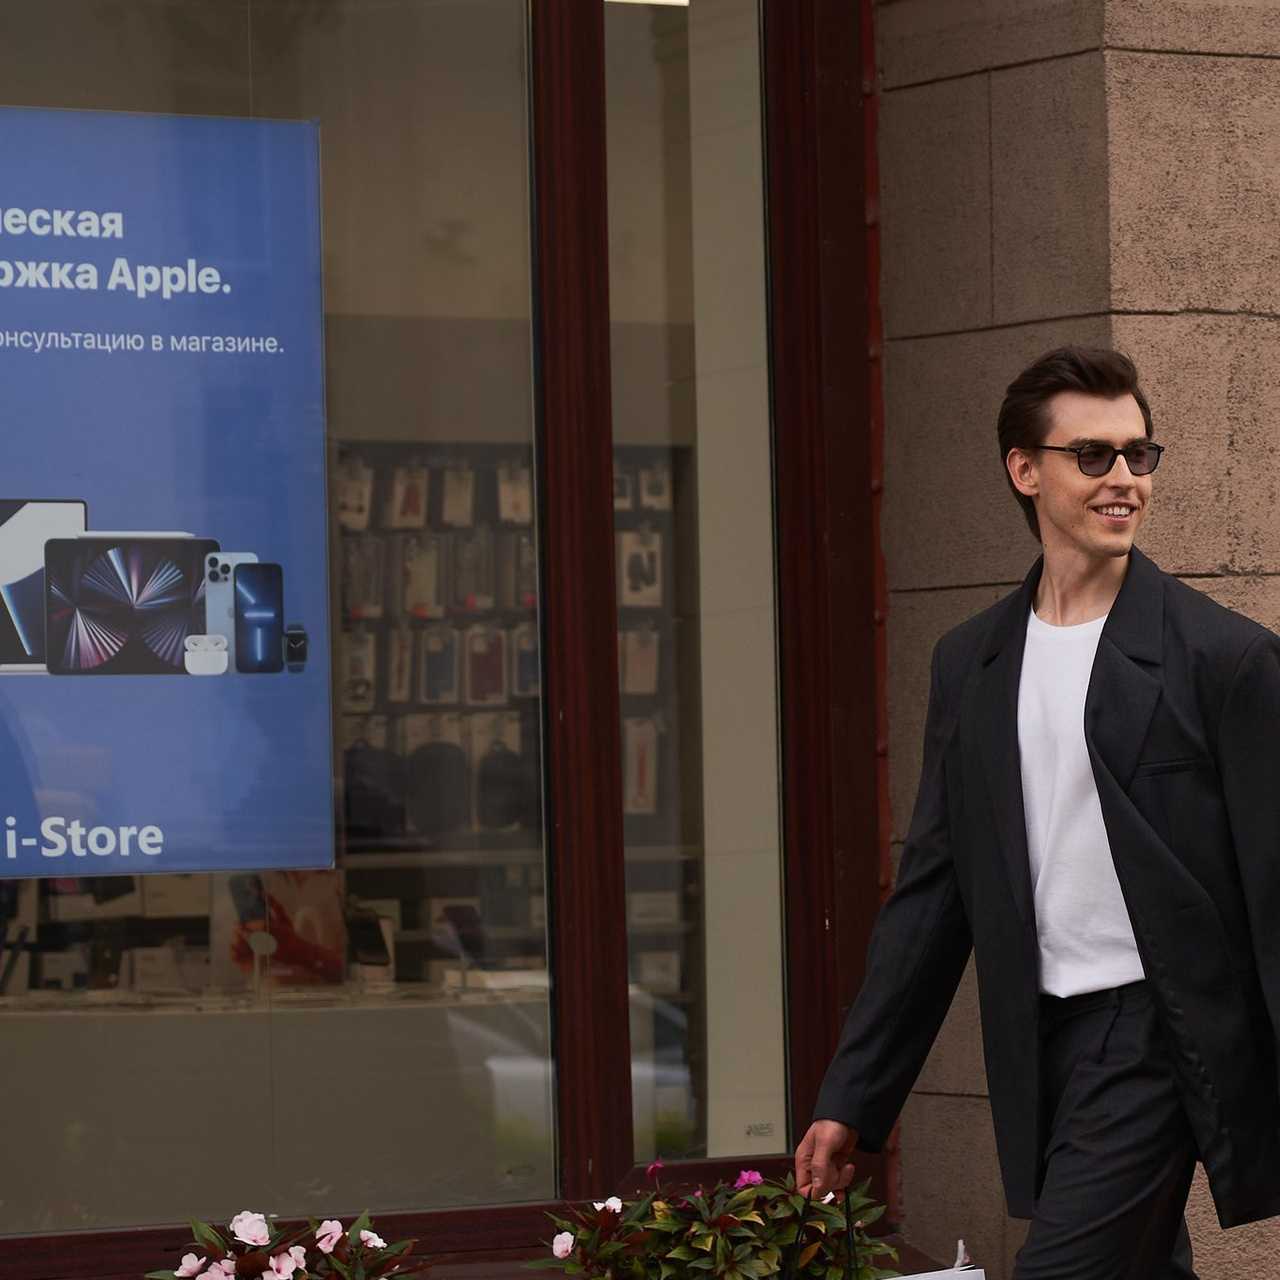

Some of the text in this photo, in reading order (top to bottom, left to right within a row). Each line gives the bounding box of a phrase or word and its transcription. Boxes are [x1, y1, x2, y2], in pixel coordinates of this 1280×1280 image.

[0, 207, 124, 238] еская
[106, 257, 232, 300] Apple.
[151, 334, 164, 351] в
[170, 335, 285, 354] магазине.
[5, 816, 164, 859] i-Store
